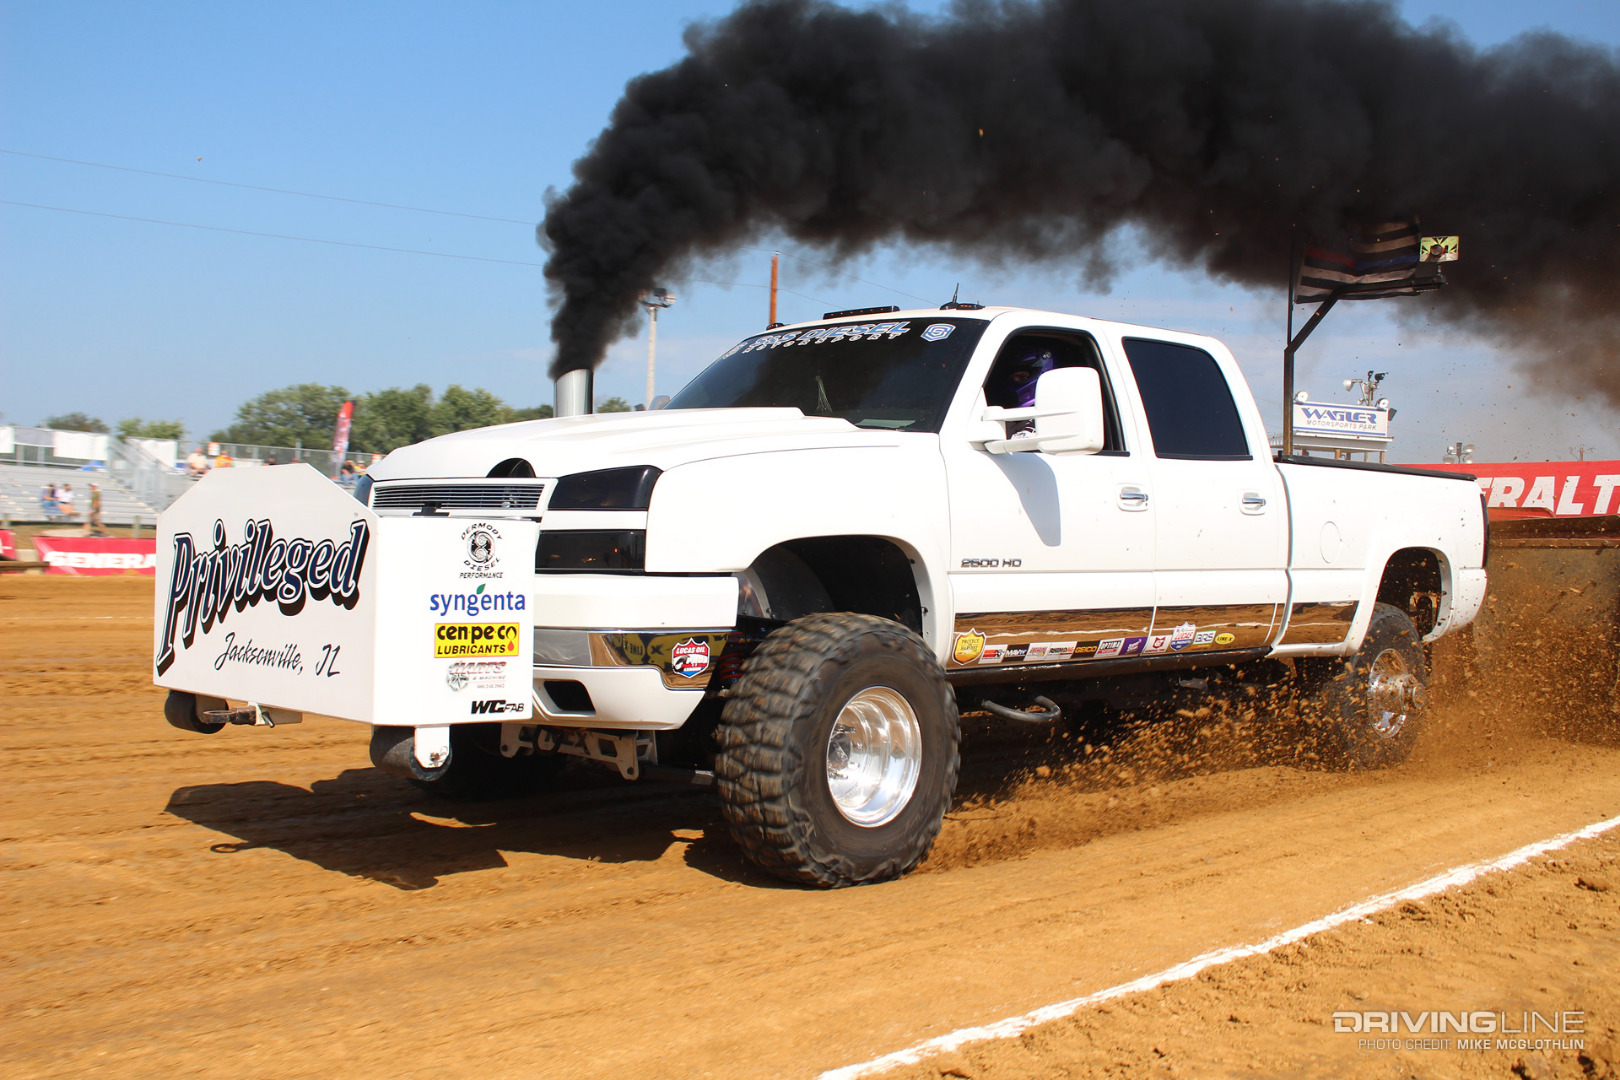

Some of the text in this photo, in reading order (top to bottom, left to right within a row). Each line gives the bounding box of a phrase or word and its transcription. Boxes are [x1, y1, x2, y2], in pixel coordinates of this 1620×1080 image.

[797, 322, 910, 341] DIESEL
[1301, 407, 1377, 424] WAGLER
[1306, 419, 1377, 431] MOTORSPORTS PARK
[460, 522, 502, 541] DERMODY
[463, 557, 500, 572] DIESEL
[961, 558, 1022, 568] 2500 HD
[459, 572, 503, 580] PERFORMANCE
[156, 518, 370, 677] Privileged
[430, 591, 526, 617] syngenta
[214, 632, 303, 675] Jacksonville,
[437, 645, 506, 655] LUBRICANTS
[676, 646, 696, 654] LUCAS
[1075, 645, 1098, 654] GEICO
